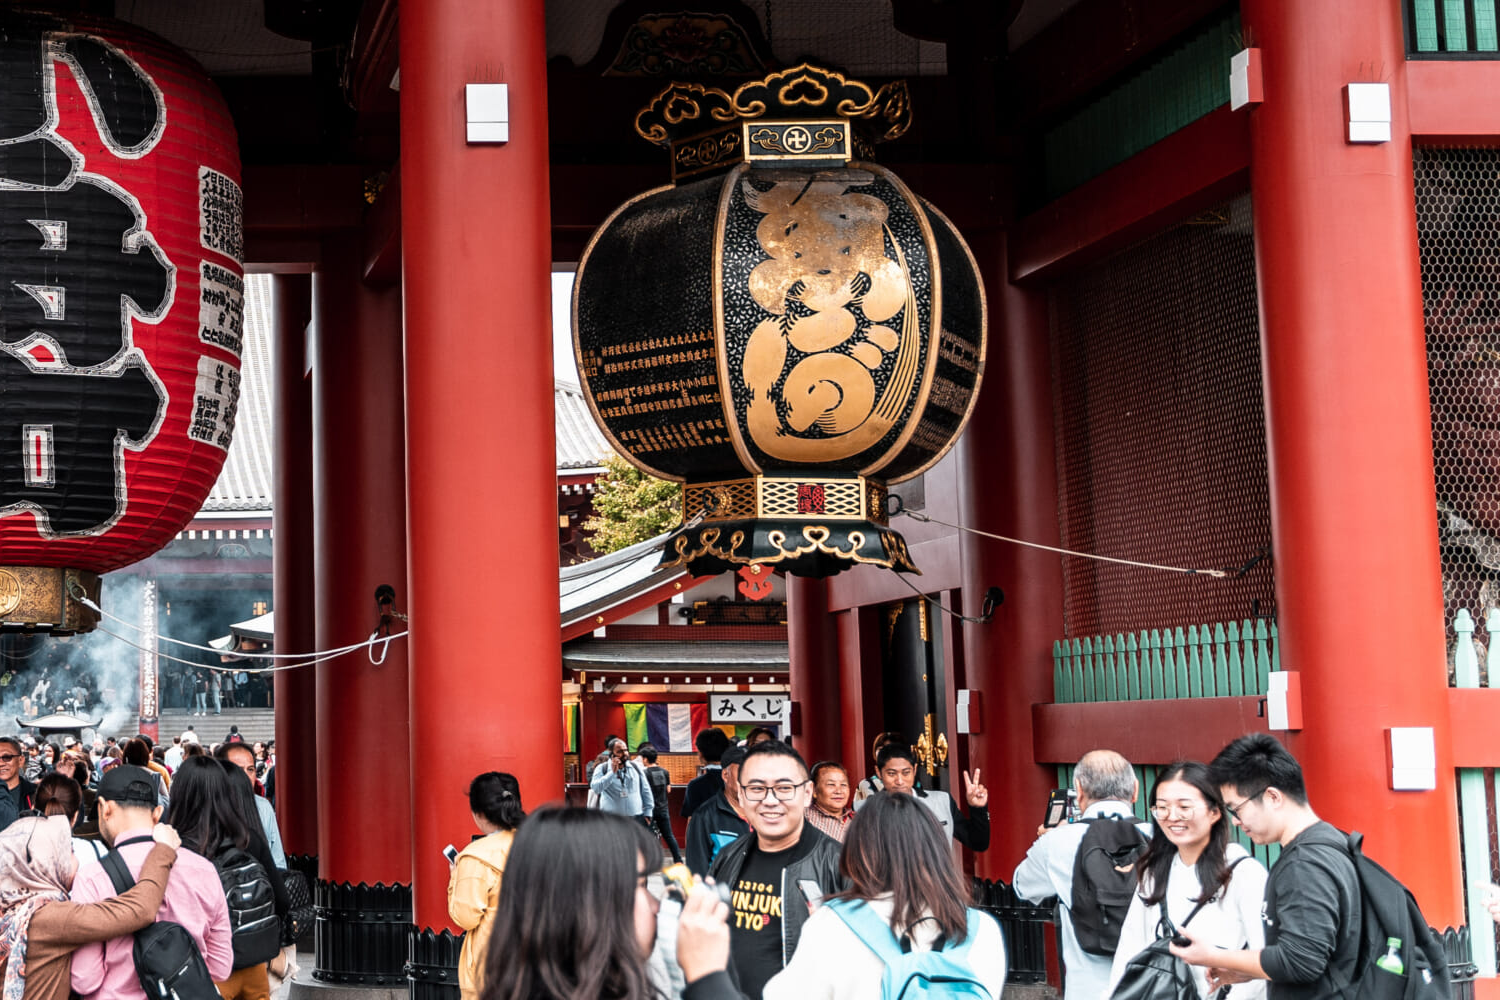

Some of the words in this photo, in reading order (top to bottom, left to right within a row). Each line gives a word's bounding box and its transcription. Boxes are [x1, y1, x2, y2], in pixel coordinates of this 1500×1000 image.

[718, 698, 782, 717] みくじ
[739, 880, 773, 893] 13104
